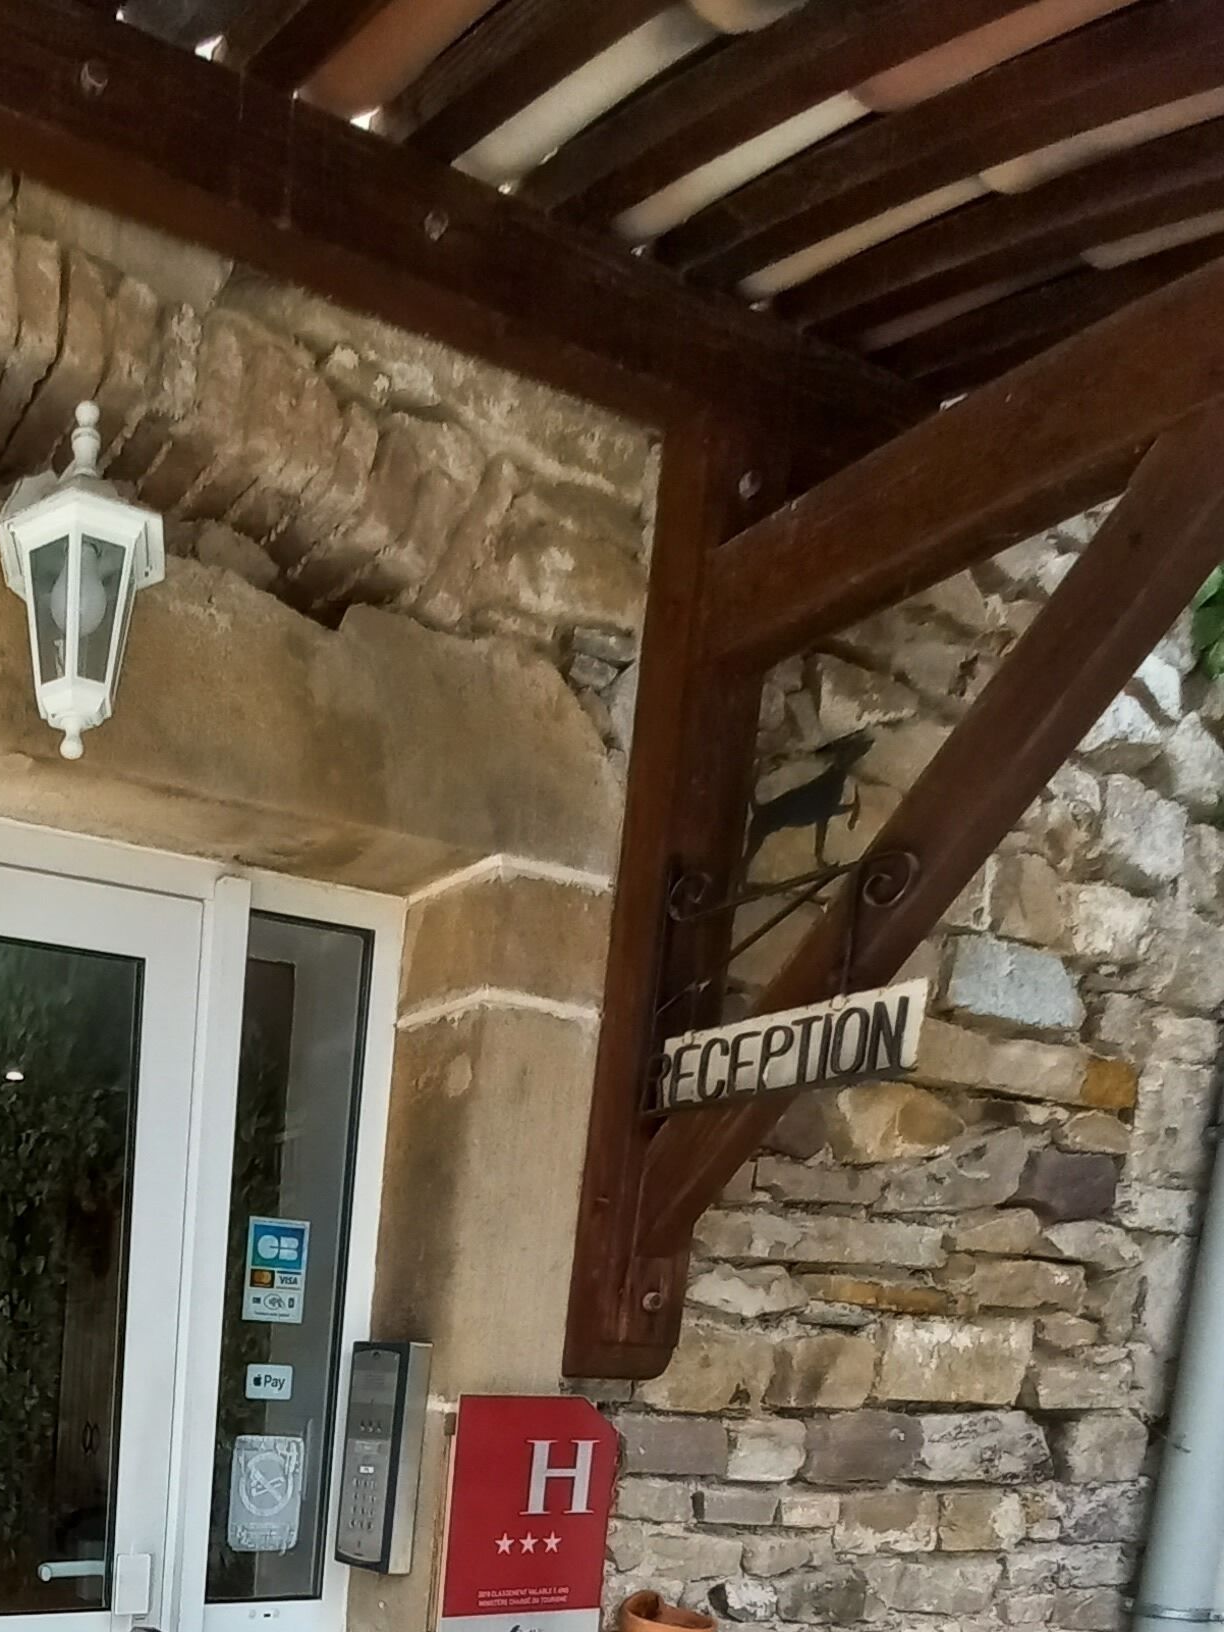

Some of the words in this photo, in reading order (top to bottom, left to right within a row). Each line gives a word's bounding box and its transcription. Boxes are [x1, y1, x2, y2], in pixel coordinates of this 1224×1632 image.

[279, 1275, 298, 1285] VISA
[263, 1374, 286, 1391] Pay
[519, 1438, 600, 1516] H
